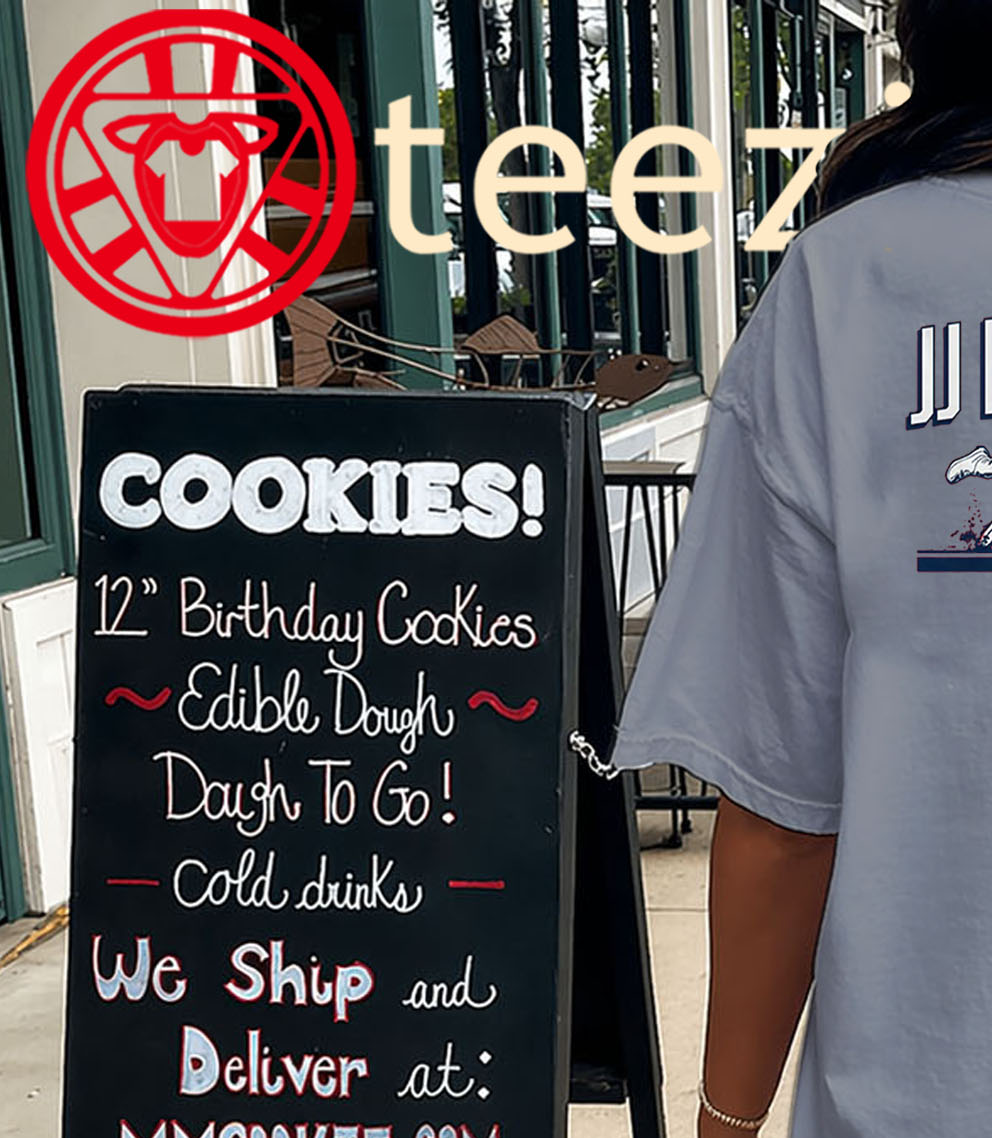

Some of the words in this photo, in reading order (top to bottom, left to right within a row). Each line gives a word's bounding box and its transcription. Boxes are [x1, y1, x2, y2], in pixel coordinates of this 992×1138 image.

[906, 322, 962, 430] JJ
[100, 452, 545, 538] COOKIES!
[180, 577, 364, 670] Birthday
[177, 662, 320, 734] Edible
[323, 667, 455, 754] Dough
[308, 758, 355, 824] To
[92, 934, 188, 1003] We
[223, 938, 375, 1023] Ship
[401, 954, 498, 1009] and
[178, 1024, 370, 1099] Deliver
